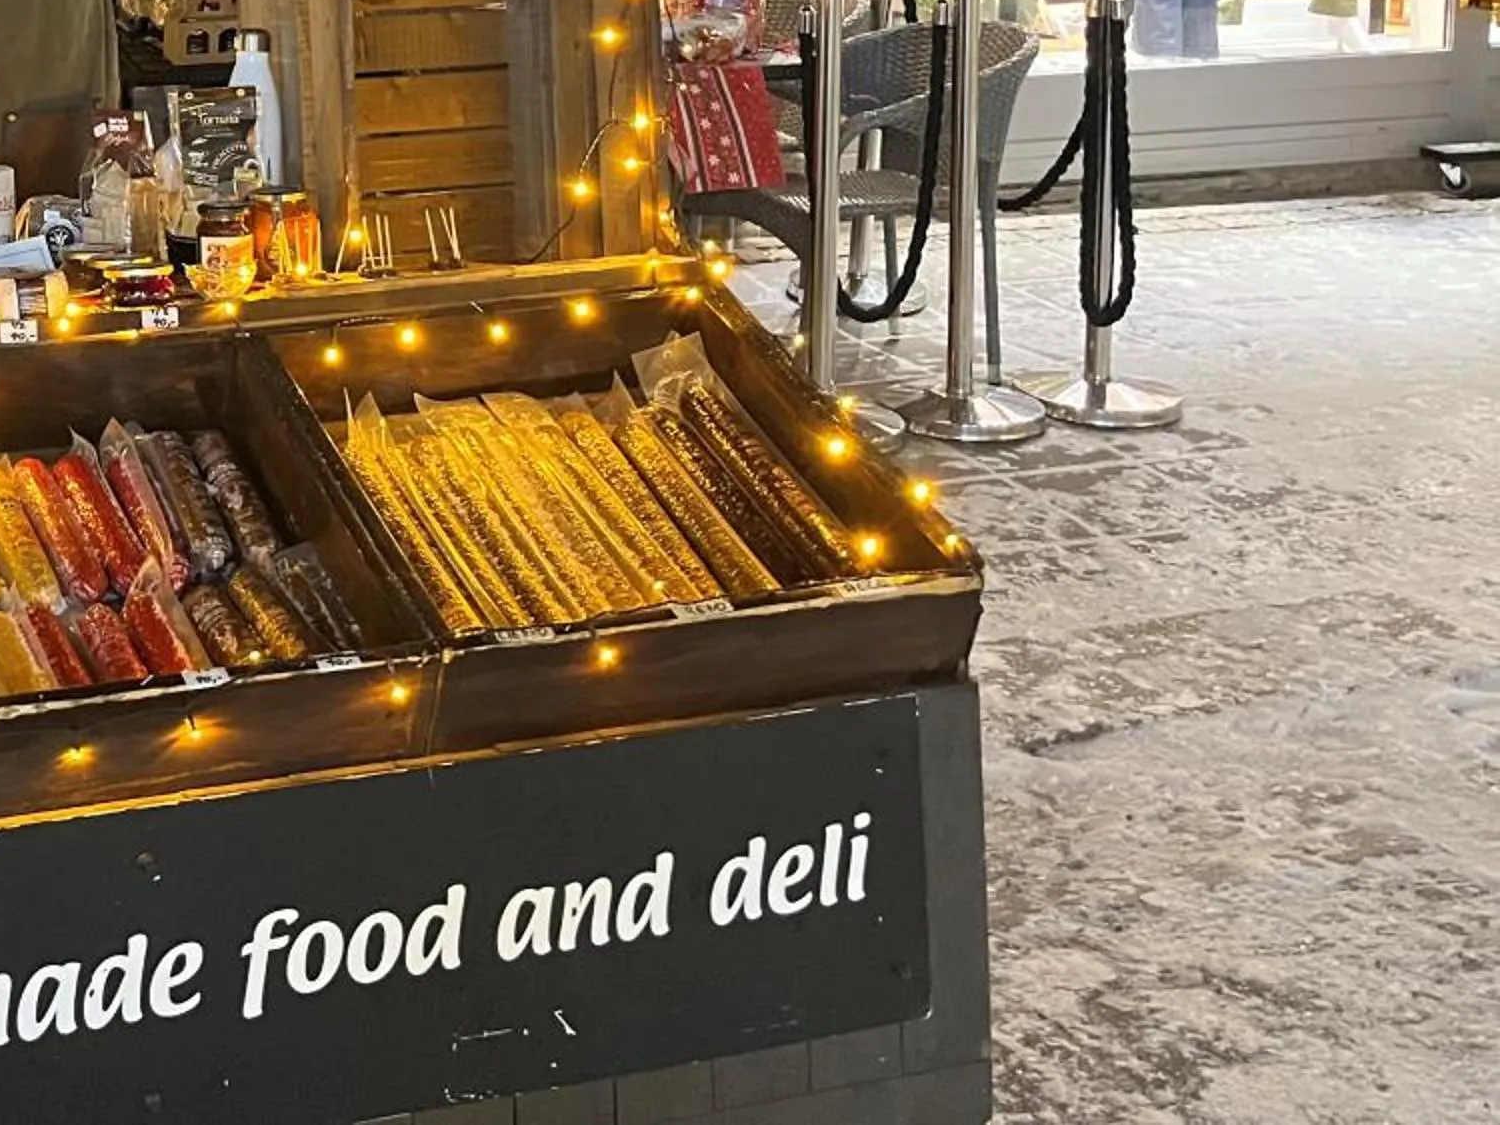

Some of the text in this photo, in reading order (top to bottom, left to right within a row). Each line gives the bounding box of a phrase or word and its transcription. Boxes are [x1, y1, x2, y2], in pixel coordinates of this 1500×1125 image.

[241, 884, 466, 1019] food
[496, 851, 675, 963] and
[709, 812, 871, 927] deli
